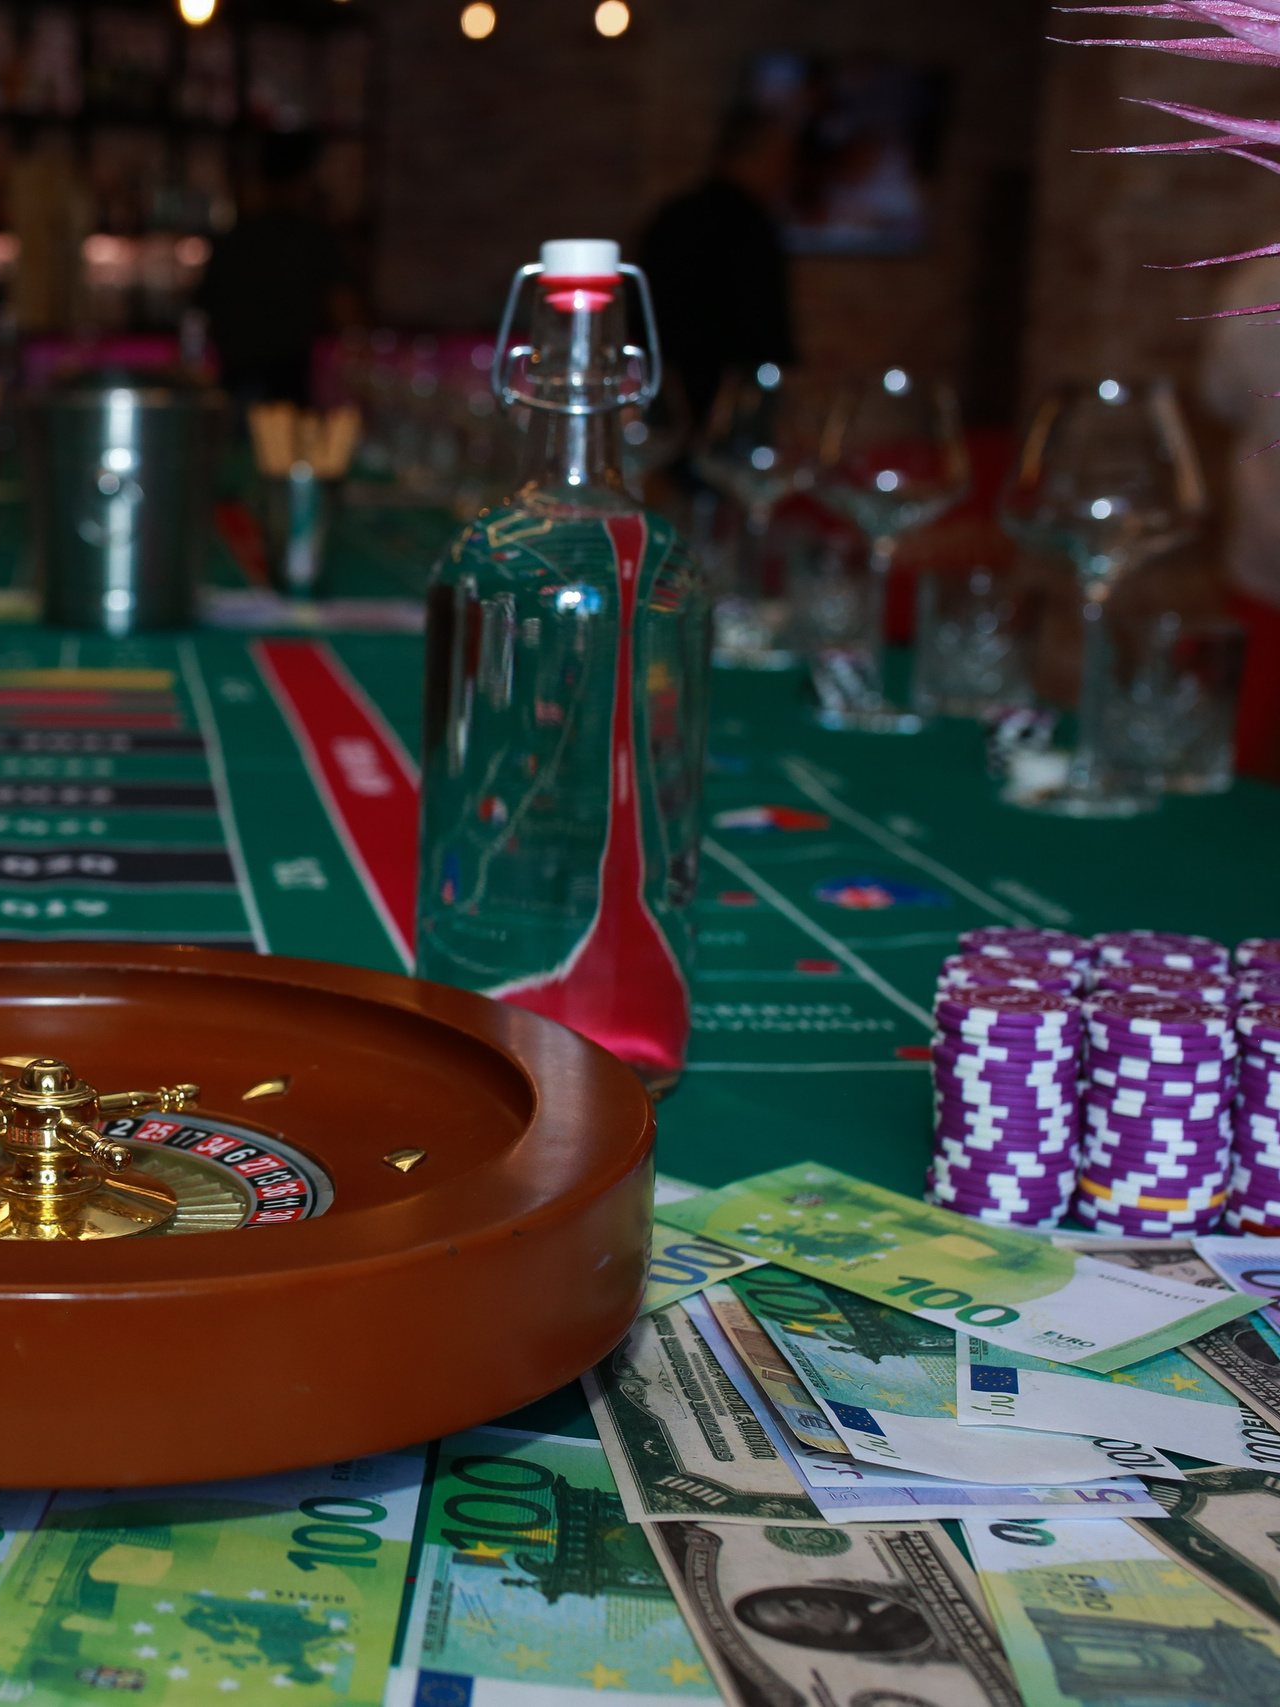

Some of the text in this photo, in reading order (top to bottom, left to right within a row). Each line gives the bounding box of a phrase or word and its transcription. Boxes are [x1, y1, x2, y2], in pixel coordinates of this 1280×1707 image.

[111, 1119, 134, 1136] 2
[137, 1122, 169, 1140] 25
[178, 1128, 207, 1147] 17
[196, 1135, 236, 1156] 34
[223, 1147, 257, 1164] 6
[237, 1157, 282, 1174] 27
[255, 1169, 293, 1185] 13
[262, 1183, 300, 1197] 36
[263, 1197, 300, 1209] 11
[261, 1210, 296, 1222] 30
[882, 1274, 1021, 1328] 100
[686, 1398, 737, 1463] DOLLARS
[1092, 1437, 1166, 1470] 100
[440, 1454, 555, 1551] 100
[286, 1495, 388, 1572] 100
